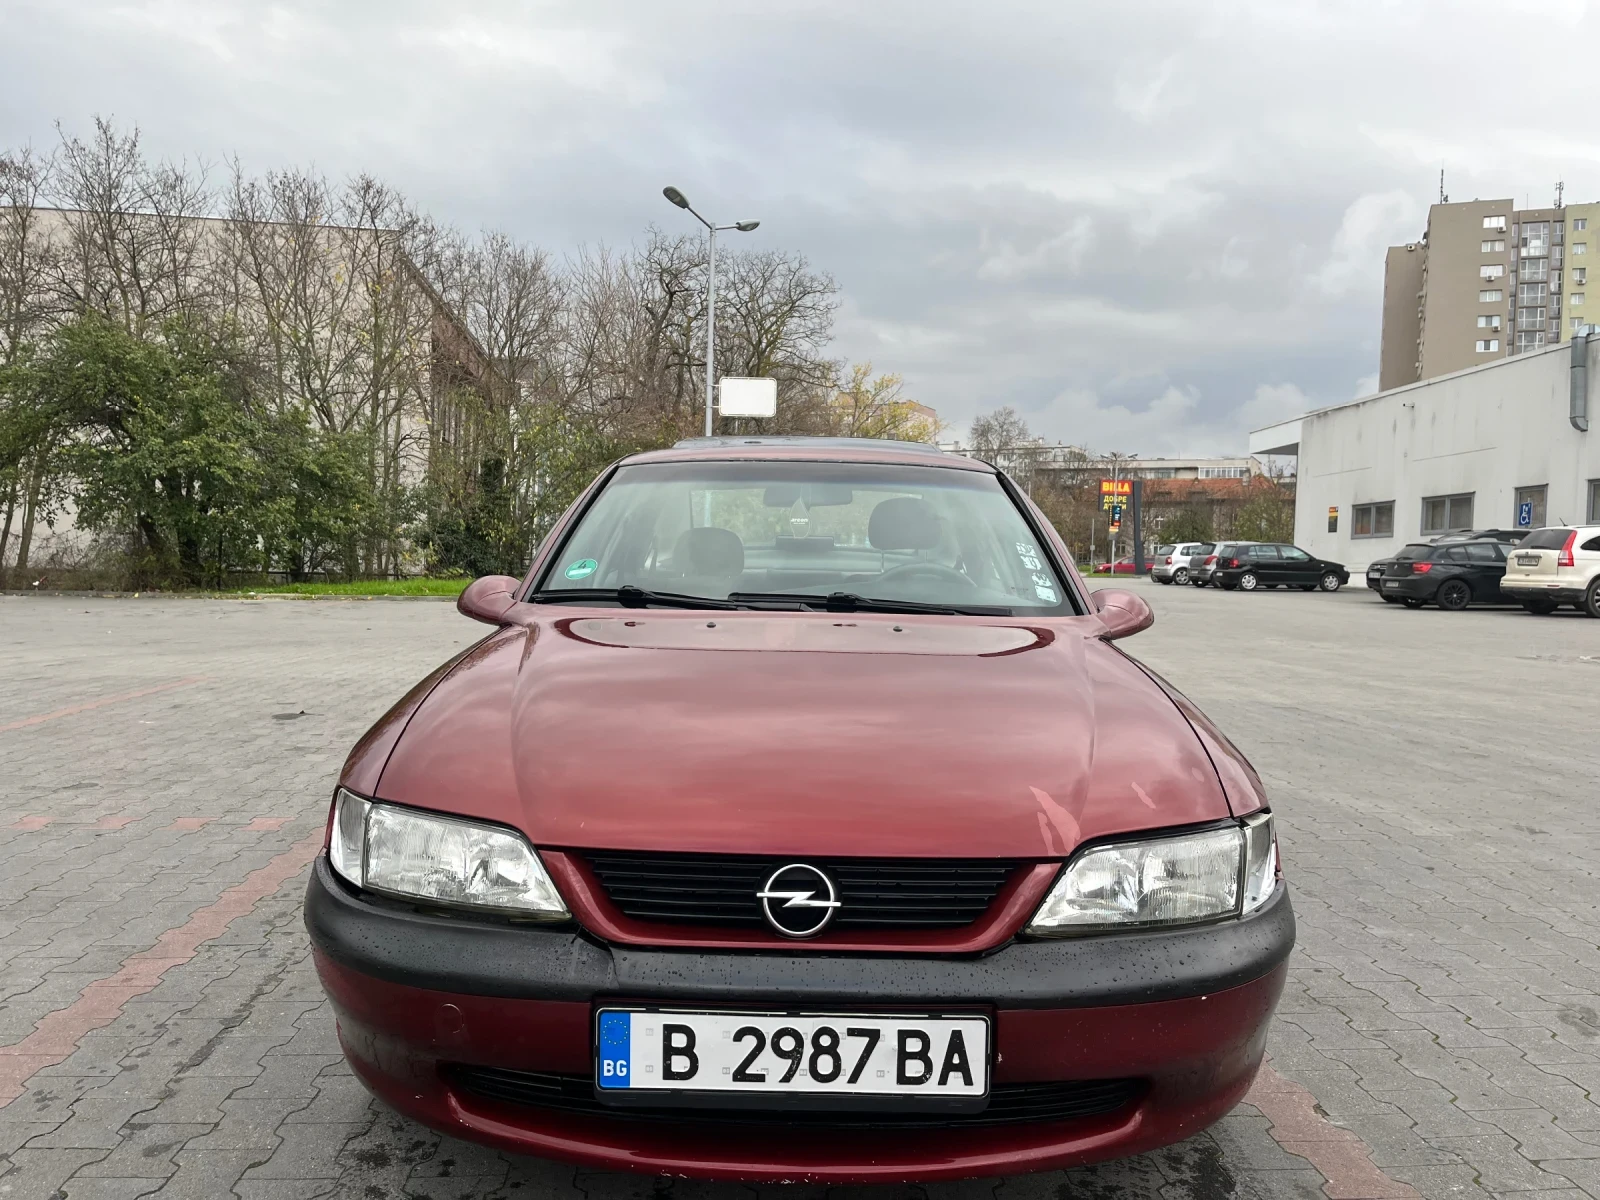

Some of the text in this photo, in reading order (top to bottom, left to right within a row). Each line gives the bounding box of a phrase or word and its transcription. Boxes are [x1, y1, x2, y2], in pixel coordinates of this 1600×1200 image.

[602, 1059, 628, 1077] BG
[662, 1023, 974, 1086] B 2987 BA
